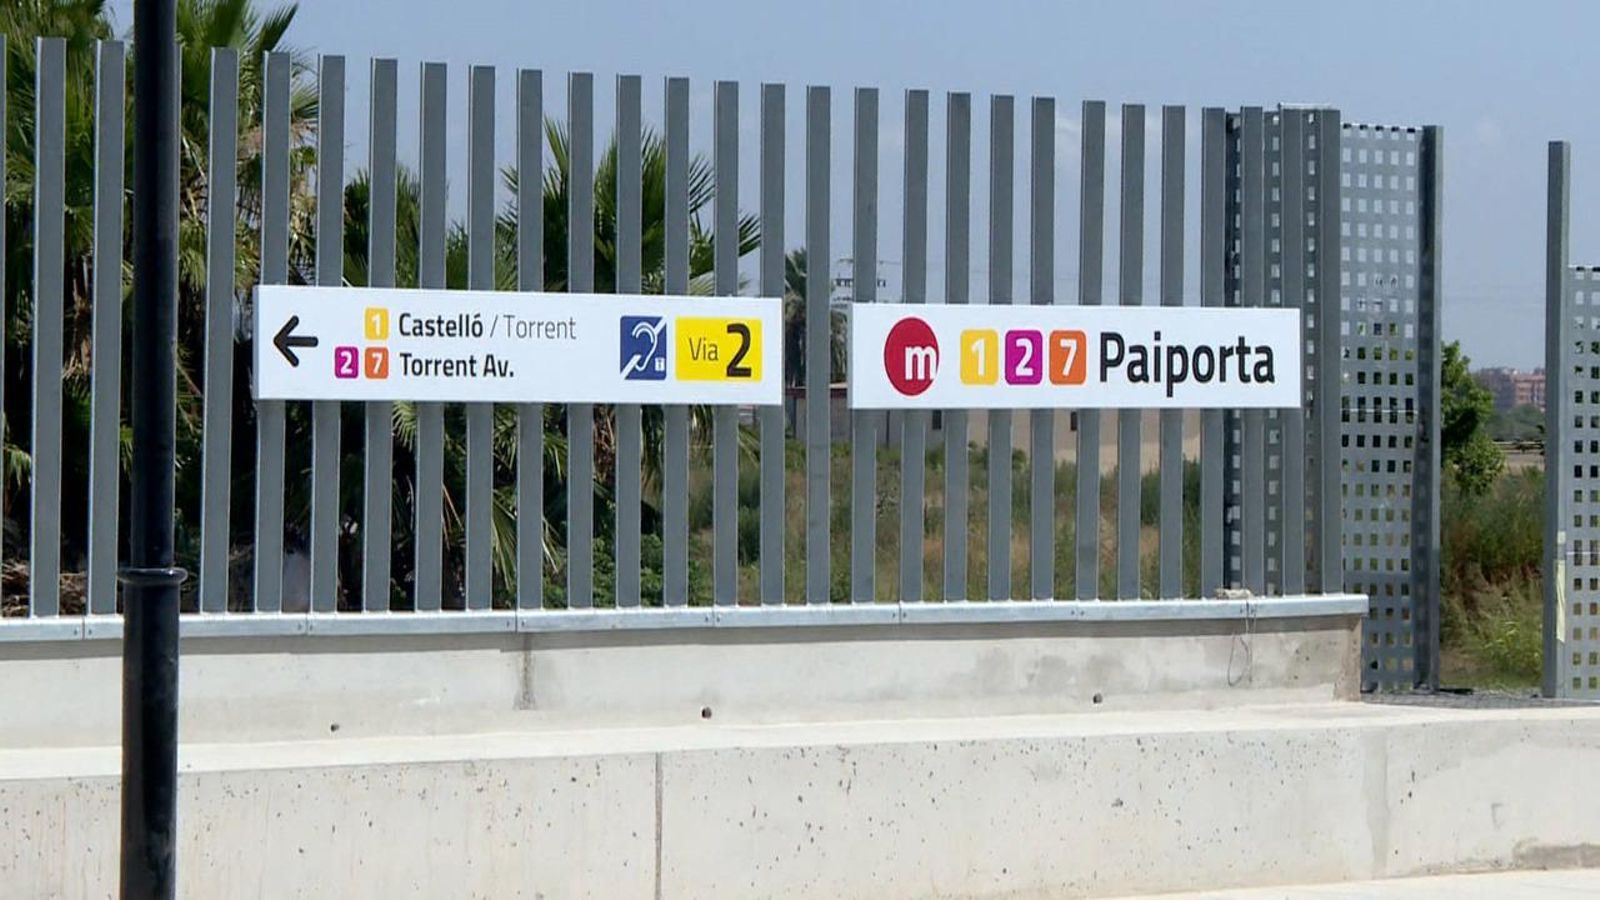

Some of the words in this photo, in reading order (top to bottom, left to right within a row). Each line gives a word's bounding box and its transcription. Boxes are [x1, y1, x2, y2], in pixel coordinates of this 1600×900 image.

[371, 313, 382, 337] 1
[399, 312, 484, 338] Castelló
[489, 314, 498, 338] /
[503, 314, 577, 340] Torrent
[340, 350, 353, 375] 2
[371, 351, 384, 375] 7
[399, 352, 477, 377] Torrent
[483, 353, 515, 378] Av.
[689, 336, 719, 361] Via
[726, 322, 752, 378] 2
[904, 345, 937, 382] m
[971, 339, 986, 377] 1
[1015, 339, 1034, 377] 2
[1060, 339, 1078, 377] 7
[1099, 330, 1276, 398] Paiporta
